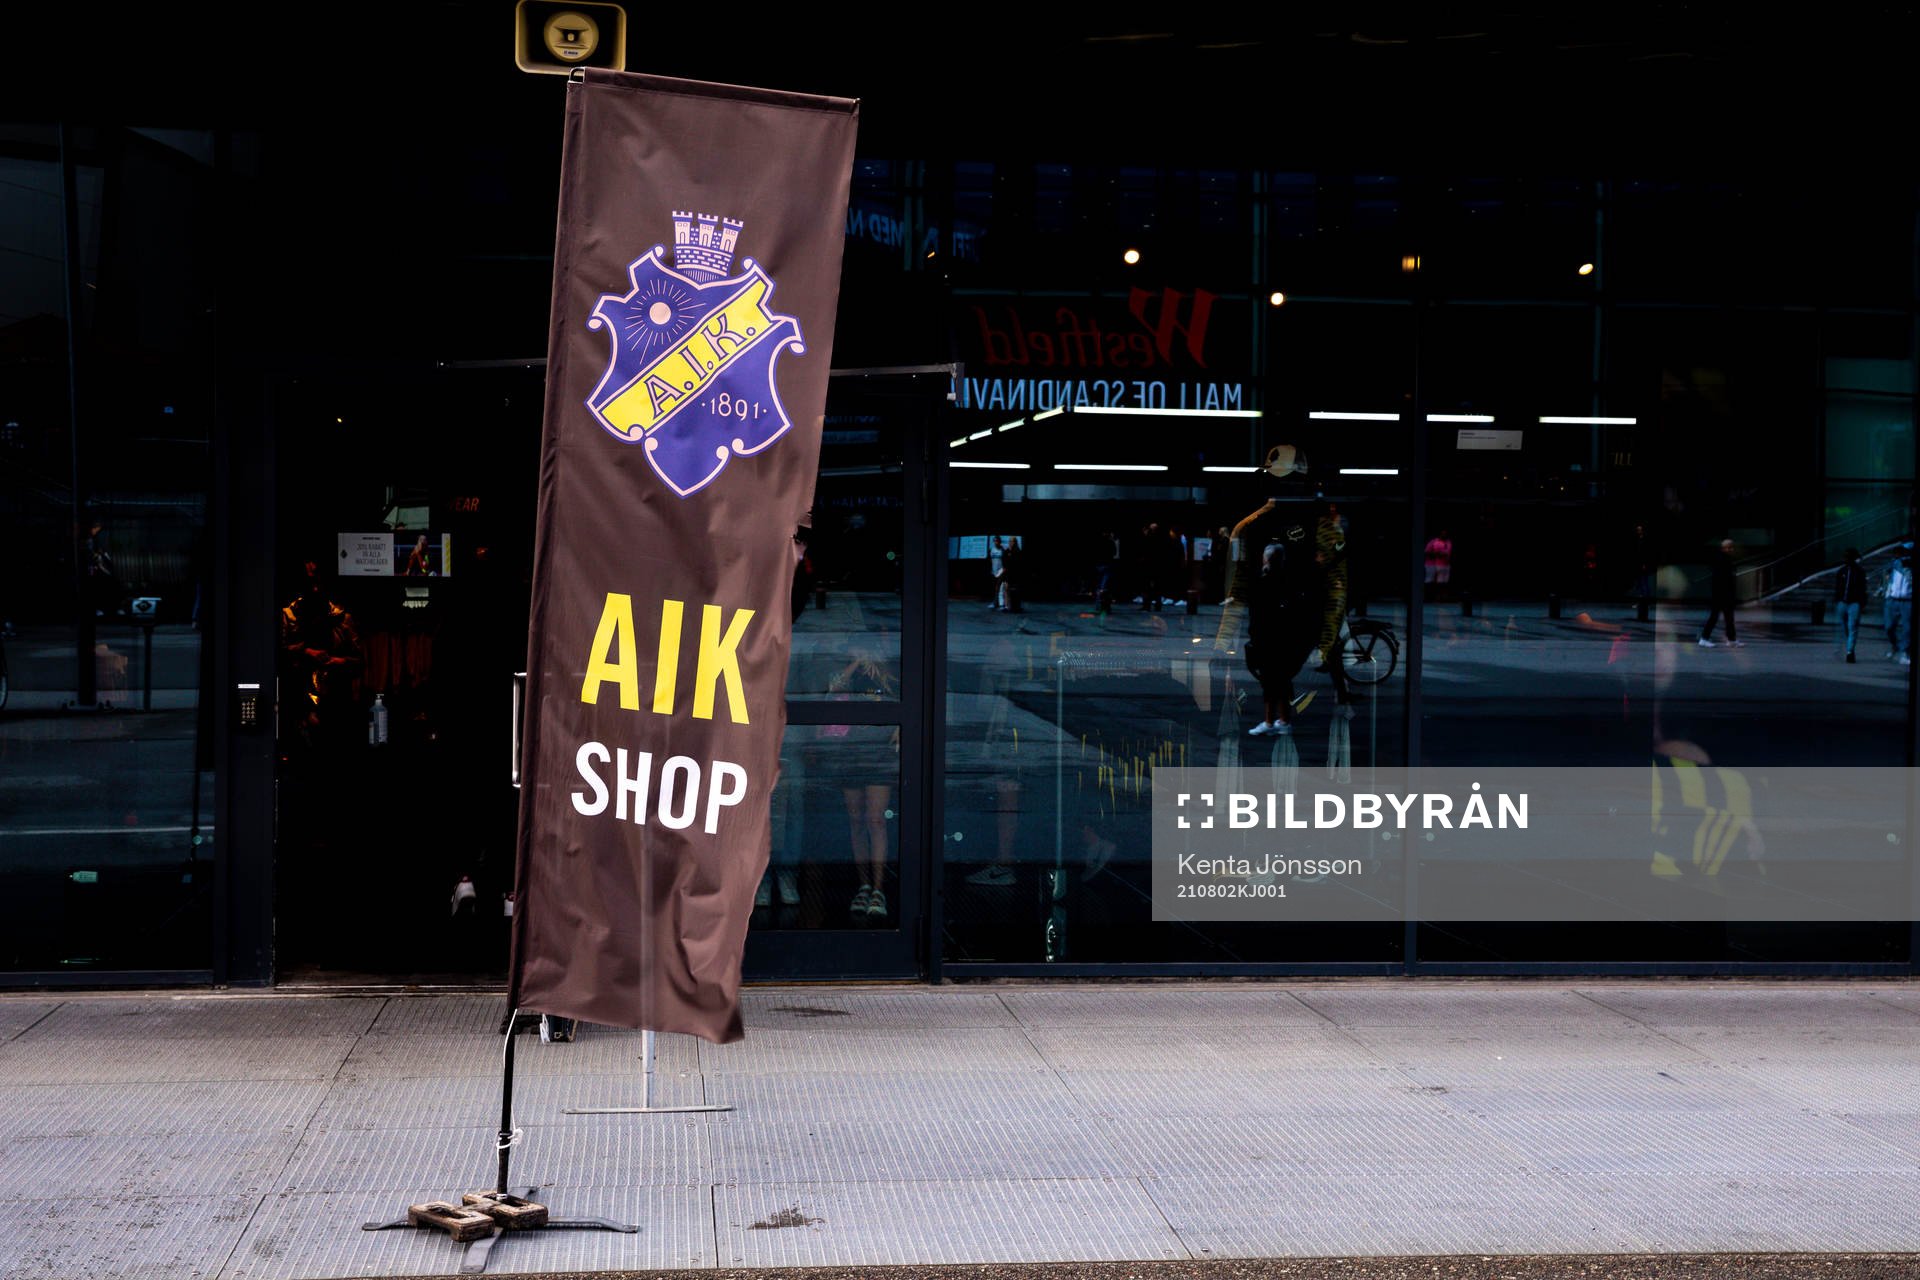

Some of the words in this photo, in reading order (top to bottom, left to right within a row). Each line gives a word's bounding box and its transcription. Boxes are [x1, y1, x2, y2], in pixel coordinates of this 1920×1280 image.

[644, 313, 756, 419] A.I.K.
[581, 592, 756, 725] AIK
[571, 741, 748, 835] SHOP
